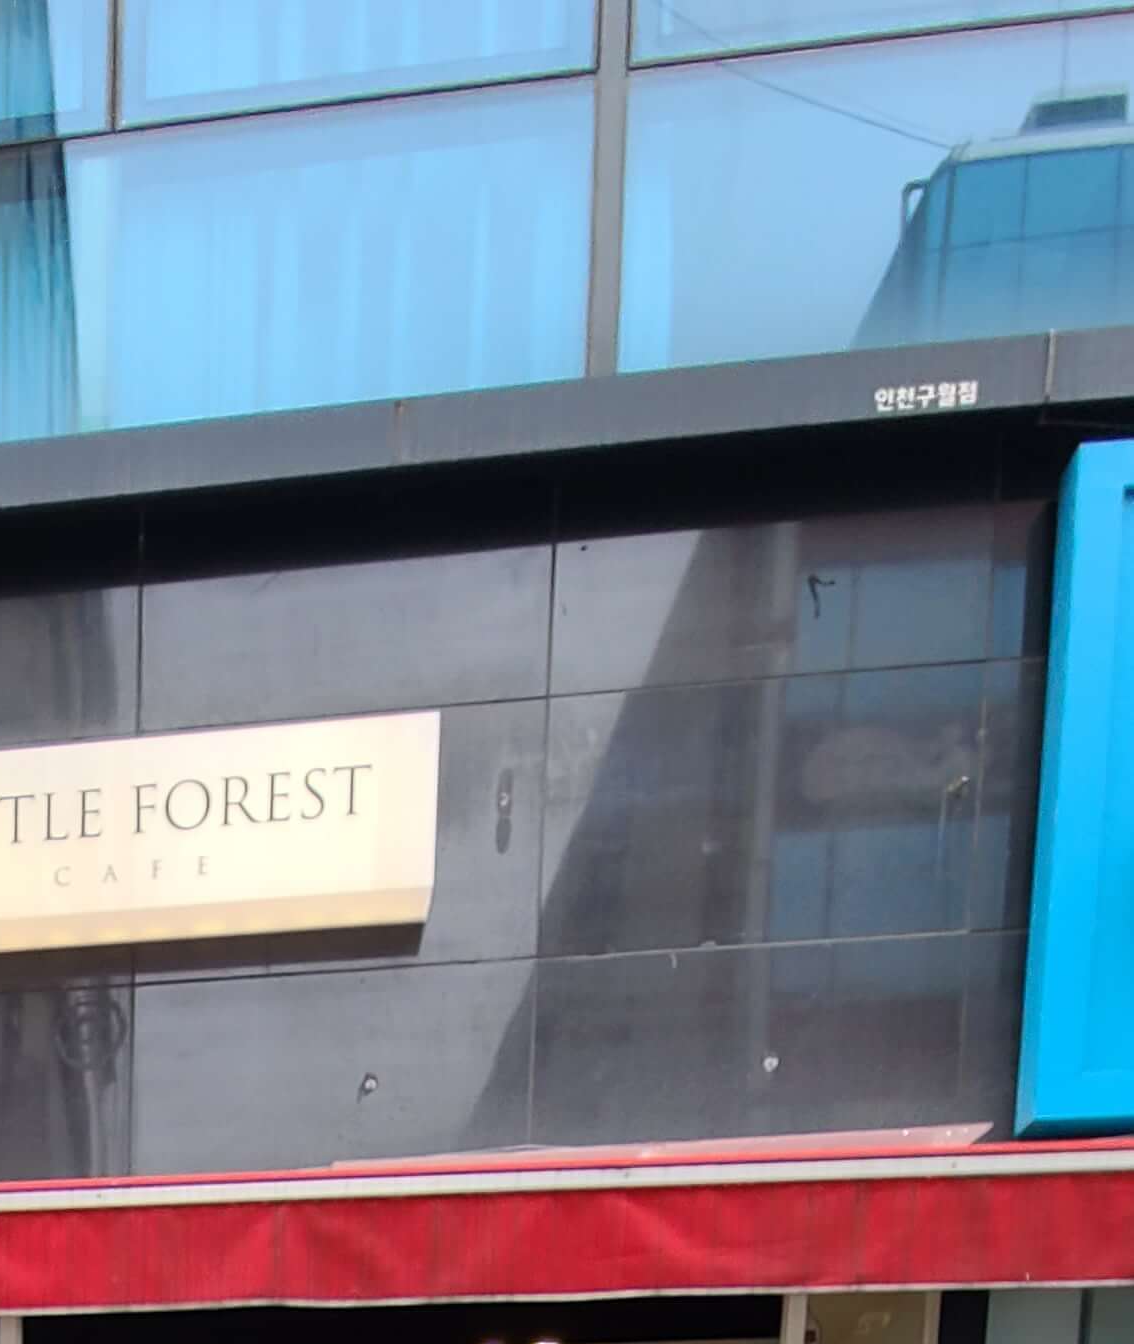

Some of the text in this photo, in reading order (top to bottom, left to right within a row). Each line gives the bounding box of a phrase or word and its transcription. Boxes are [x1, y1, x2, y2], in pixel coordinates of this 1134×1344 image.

[874, 379, 979, 413] 인천구월점
[132, 763, 374, 835] FOREST
[53, 854, 210, 888] CAFE
